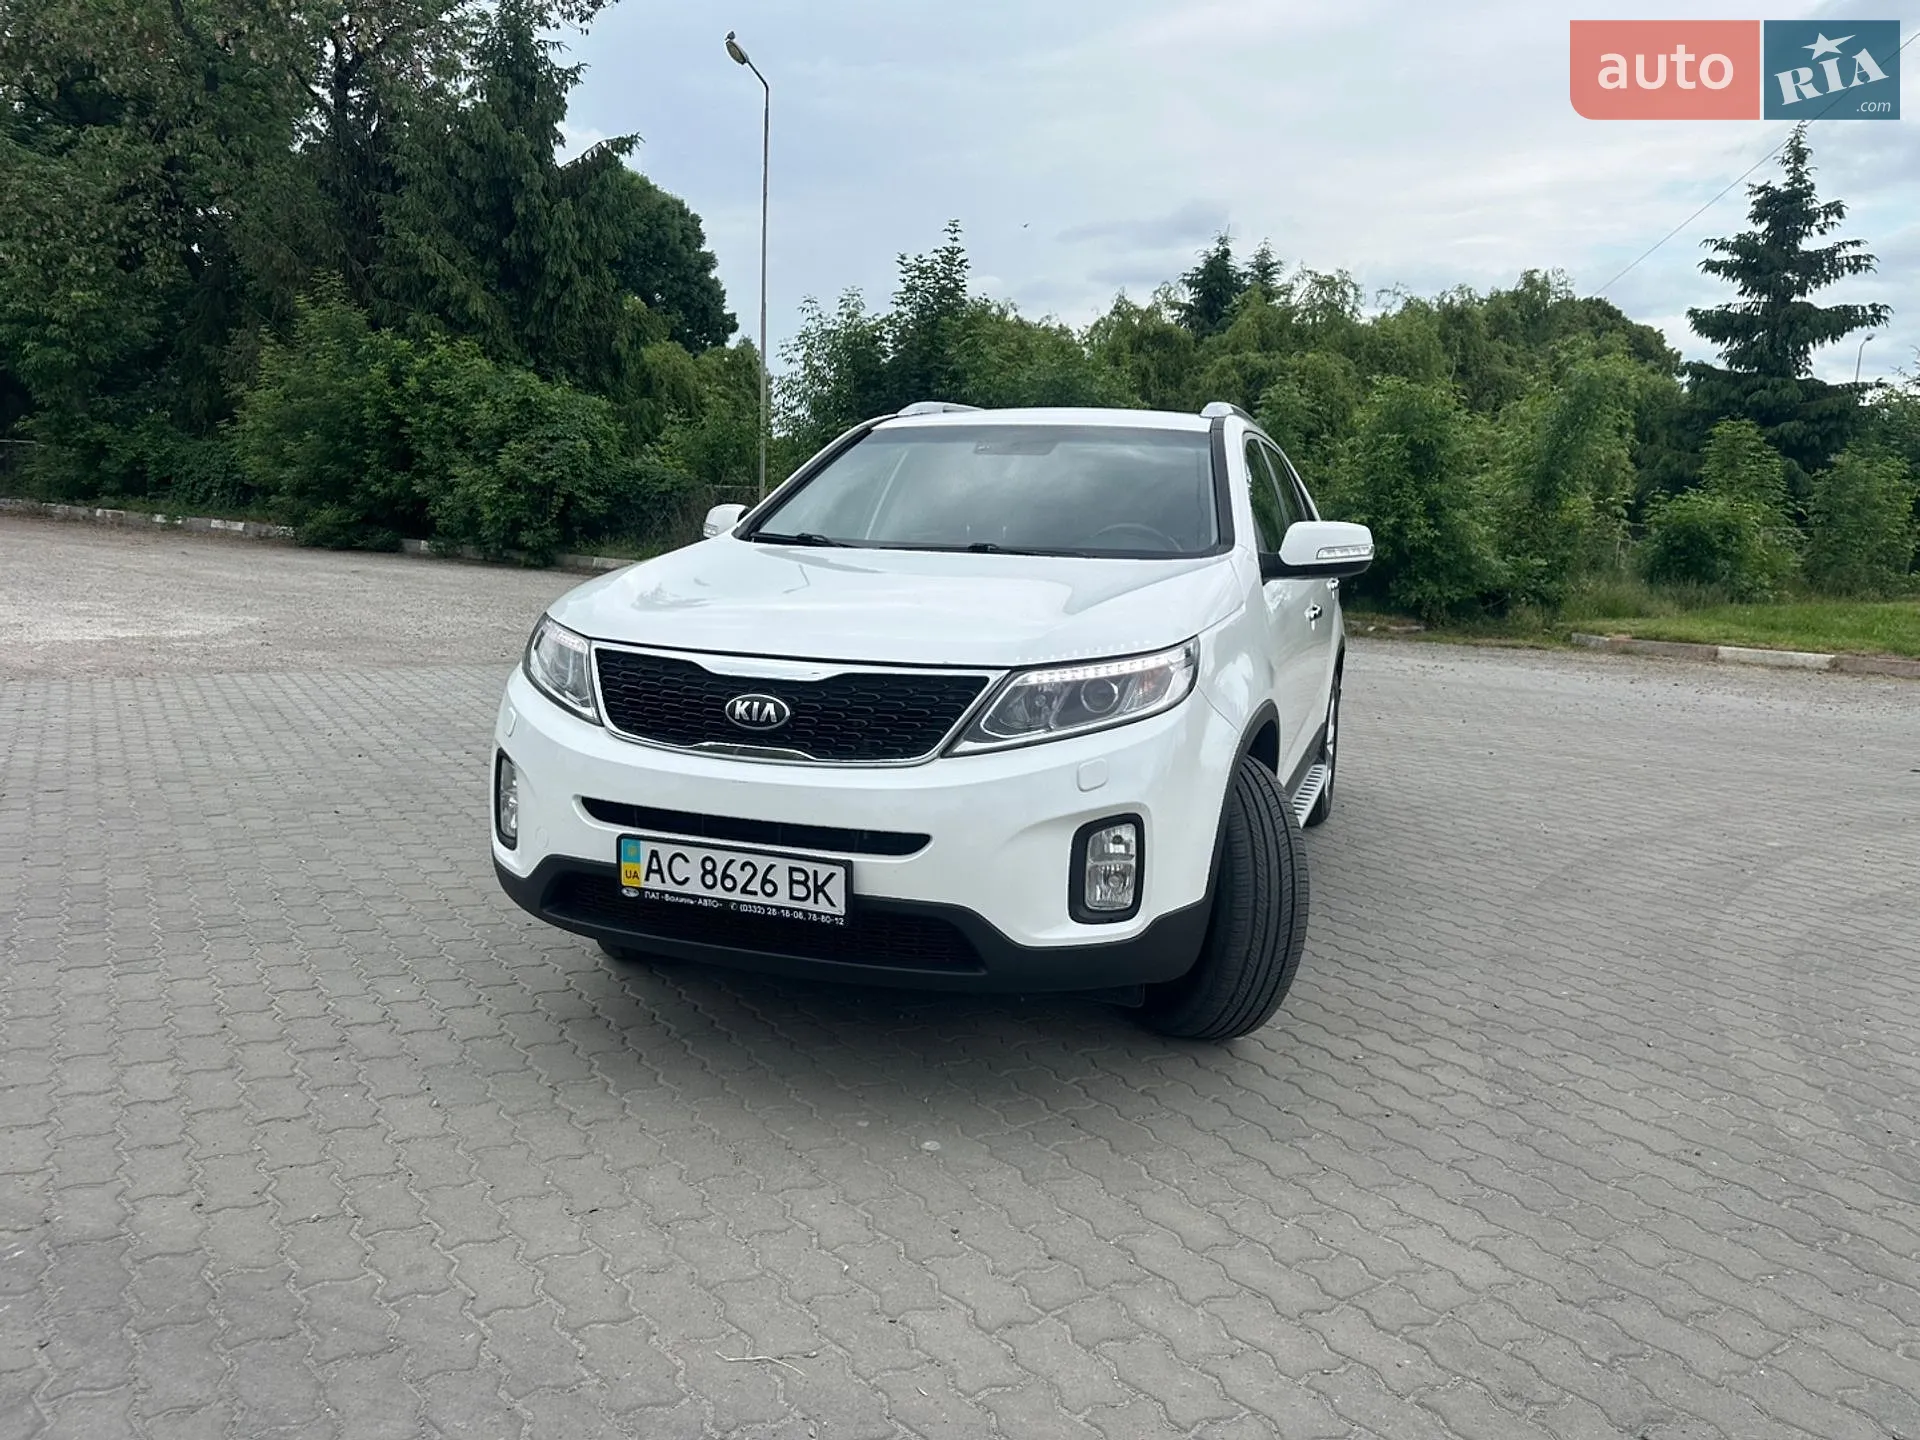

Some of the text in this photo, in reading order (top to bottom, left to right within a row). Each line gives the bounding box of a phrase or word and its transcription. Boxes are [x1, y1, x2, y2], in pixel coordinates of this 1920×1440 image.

[734, 700, 778, 723] KIA
[624, 869, 640, 880] UA
[644, 849, 837, 908] AC 8626 BK
[740, 903, 766, 915] (0332)
